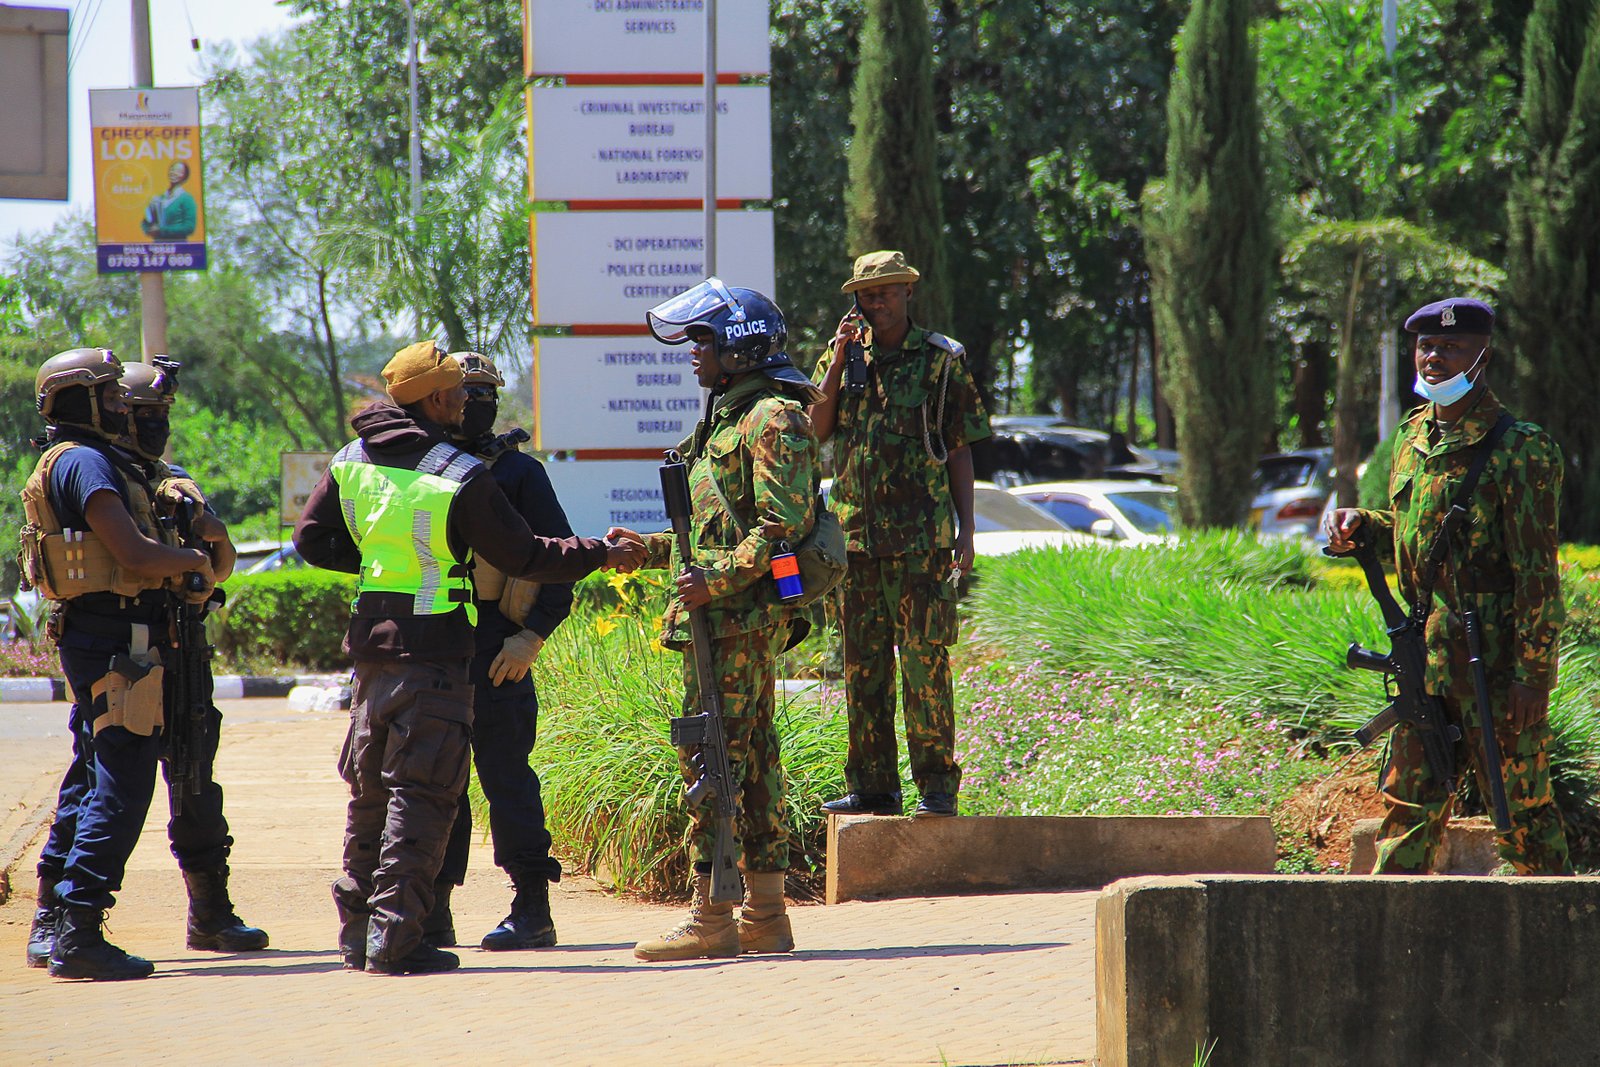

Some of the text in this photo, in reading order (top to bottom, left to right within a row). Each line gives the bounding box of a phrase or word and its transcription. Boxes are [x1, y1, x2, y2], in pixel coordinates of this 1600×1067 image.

[616, 0, 703, 11] ADMINISTRATIO
[624, 20, 676, 33] SERVICES
[580, 101, 728, 115] CRIMINAL INVESTIGATINS
[101, 127, 192, 140] CHECK-OFF
[629, 123, 675, 136] BUREAU
[102, 139, 193, 161] LOANS
[598, 149, 704, 162] NATIONAL FORENSI
[616, 170, 690, 184] LABORATORY
[614, 238, 704, 251] DCI OPERATIONS
[143, 254, 166, 267] 147
[607, 263, 704, 277] POLICE CLEARANC
[725, 320, 767, 340] POLICE
[604, 352, 657, 366] INTERPOL
[636, 374, 682, 387] BUREAU
[608, 398, 700, 412] NATIONAL CENTR
[637, 421, 683, 434] BUREAU
